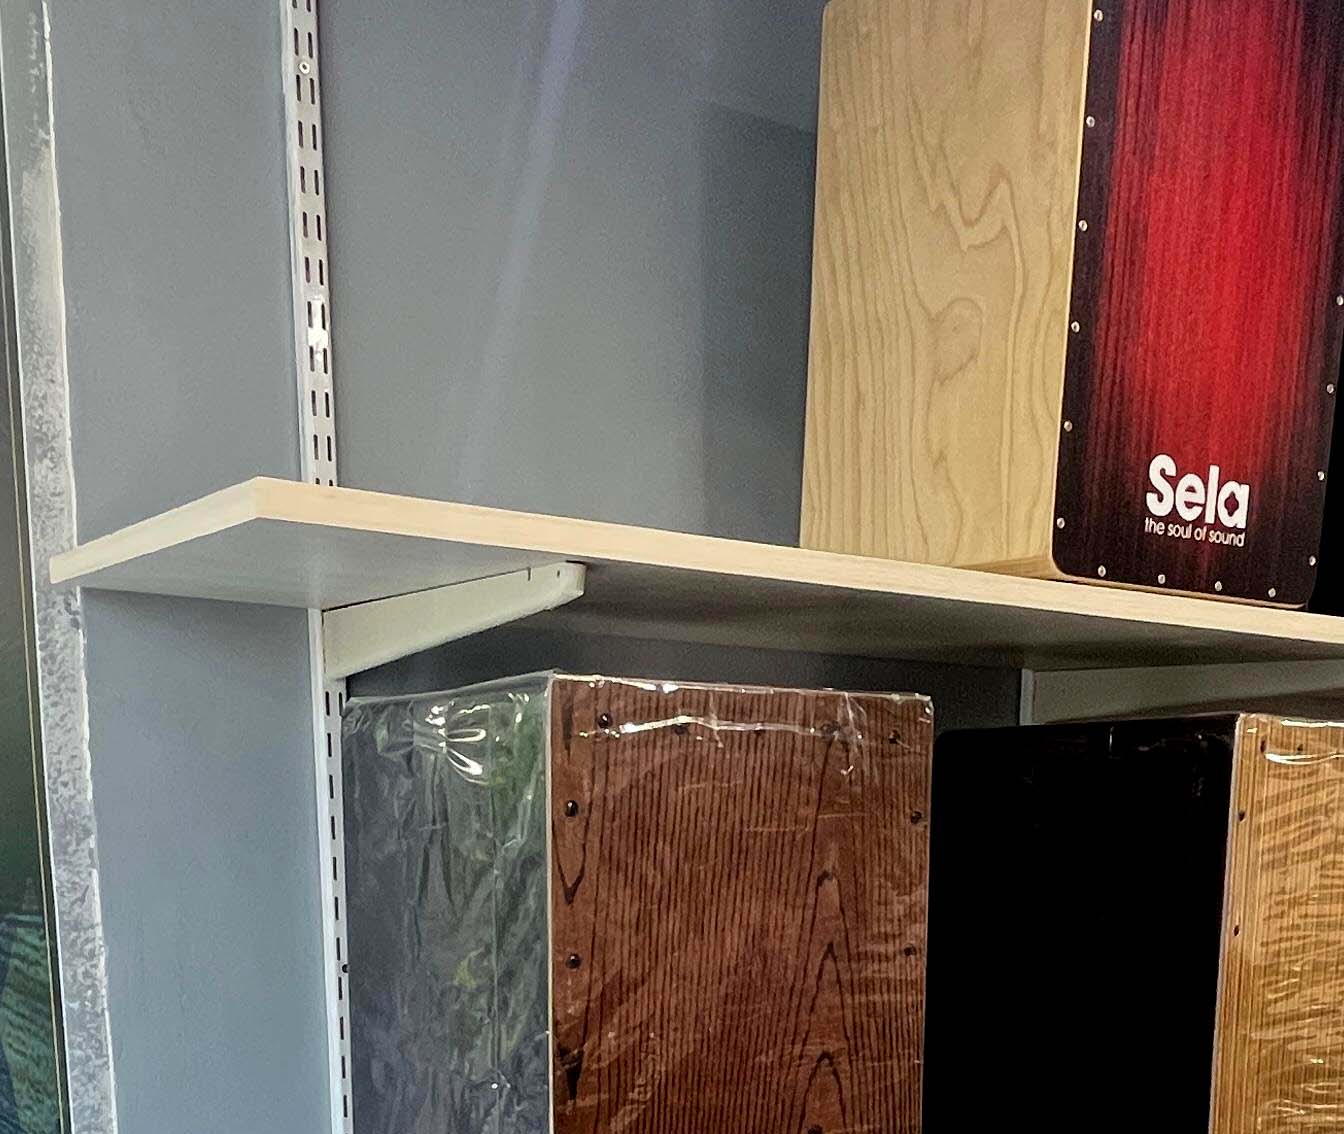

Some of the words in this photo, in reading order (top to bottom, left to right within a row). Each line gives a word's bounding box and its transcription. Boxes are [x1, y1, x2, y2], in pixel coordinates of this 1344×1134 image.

[1145, 453, 1250, 529] Sela
[1144, 516, 1165, 536] the
[1167, 522, 1192, 540] soul
[1193, 525, 1206, 542] of
[1208, 530, 1245, 548] sound
